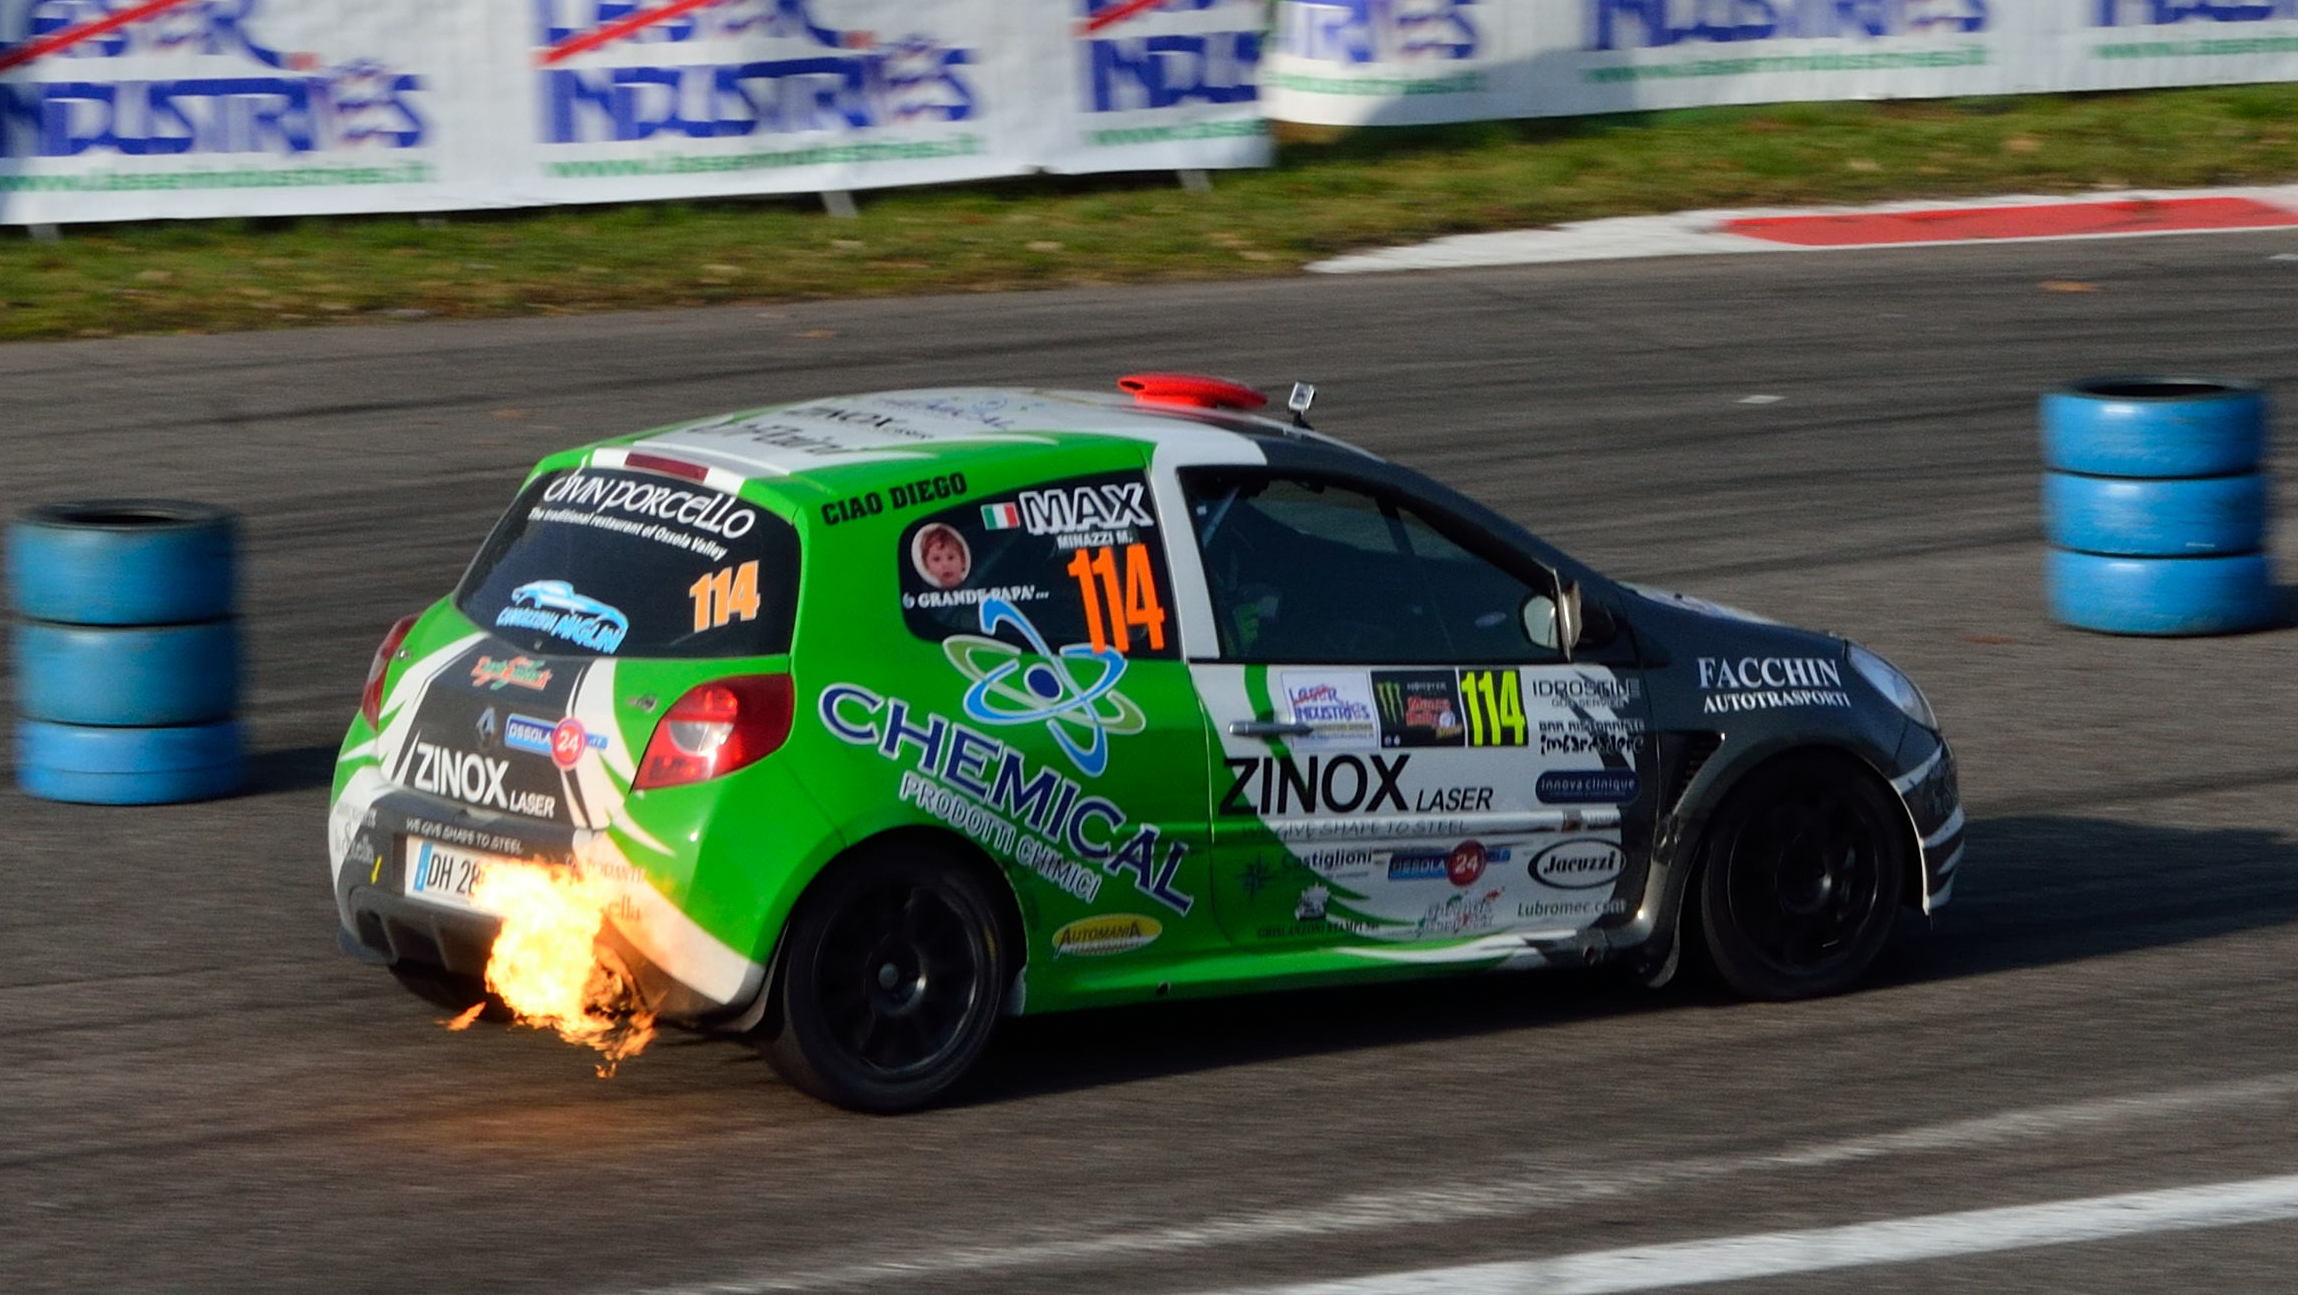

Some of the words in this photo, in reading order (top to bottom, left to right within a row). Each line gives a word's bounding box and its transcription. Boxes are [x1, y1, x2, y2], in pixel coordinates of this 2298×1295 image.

[821, 492, 884, 526] CIAO
[888, 472, 968, 511] DIEGO
[1018, 482, 1154, 536] MAX
[544, 509, 592, 527] traditional
[589, 512, 641, 536] restaurant
[641, 524, 655, 537] of
[655, 526, 691, 549] Ossola
[692, 537, 728, 562] Valley
[1056, 531, 1113, 550] MINAZZI
[688, 560, 762, 634] 114
[917, 588, 988, 609] GRANDE
[1067, 543, 1166, 655] 114
[1697, 656, 1842, 691] FACCHIN
[1460, 670, 1527, 747] 114
[1703, 690, 1851, 714] AUTOTRASPORTI
[557, 730, 580, 753] 24
[413, 741, 509, 808] ZINOX
[509, 792, 555, 818] LASER
[818, 682, 1194, 916] CHEMICAL
[1218, 753, 1410, 815] ZINOX
[1416, 787, 1494, 812] LASER
[406, 816, 421, 832] WE
[421, 821, 443, 838] GIVE
[442, 825, 476, 846] SHAPE
[476, 831, 491, 848] TO
[490, 836, 525, 855] STEEL
[899, 771, 1017, 856] PRODOTTI
[1015, 834, 1103, 904] CHIMICI
[1276, 821, 1313, 841] GIVE
[1319, 820, 1377, 837] SHAPE
[1386, 819, 1411, 834] TO
[1413, 818, 1470, 834] STEEL
[428, 852, 452, 891] DH
[1454, 853, 1478, 873] 24
[1544, 850, 1616, 875] Jacuzzi
